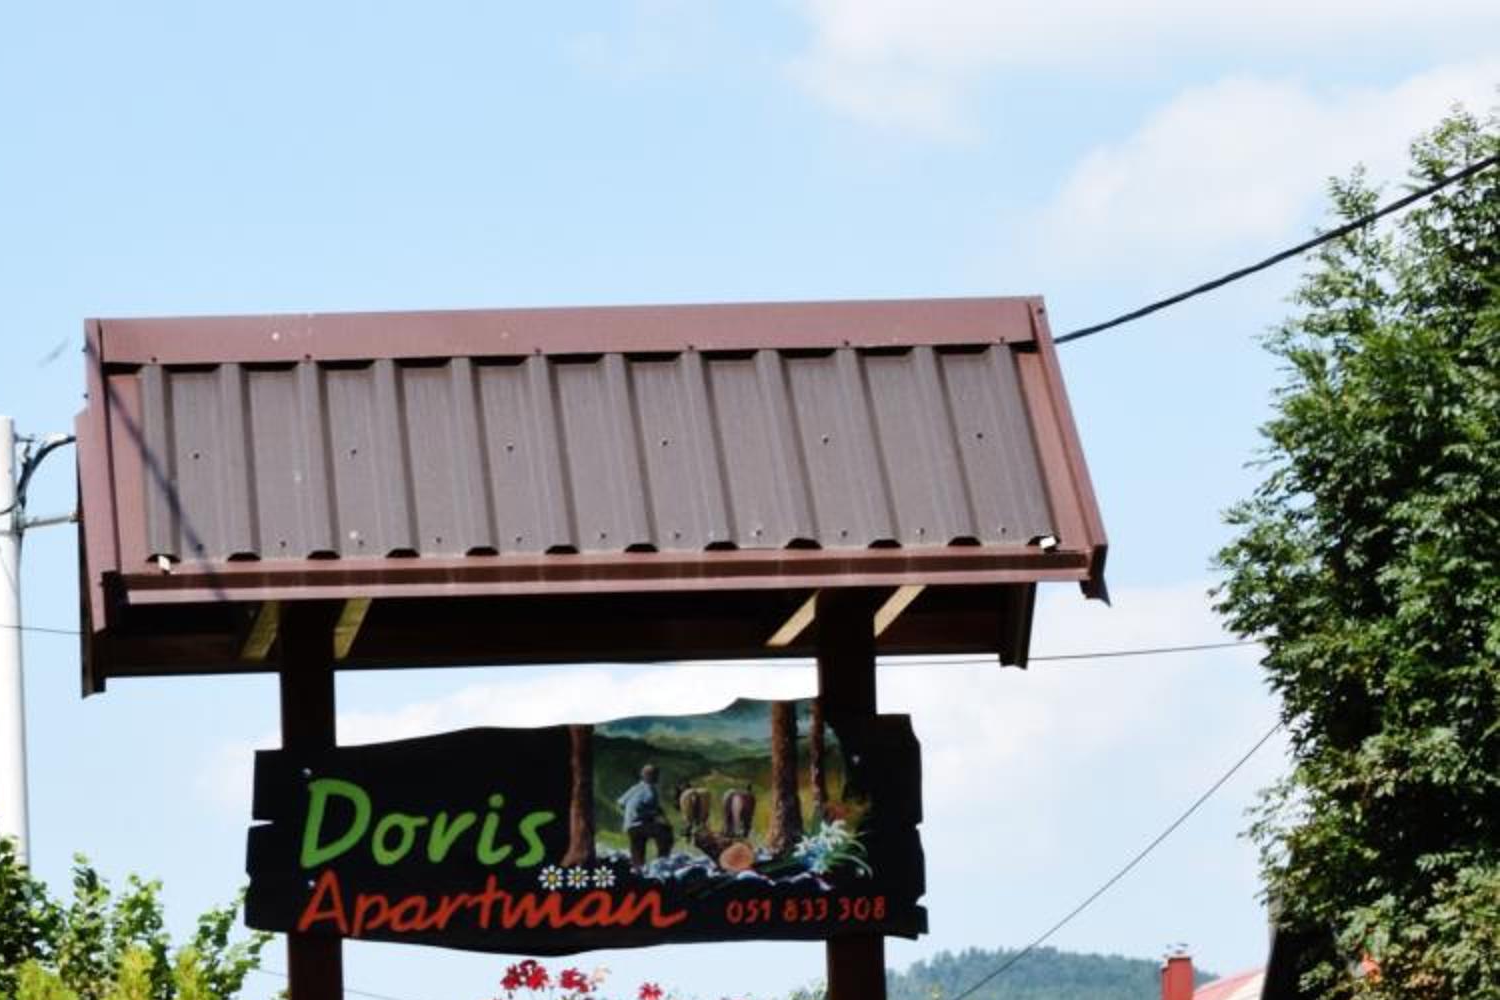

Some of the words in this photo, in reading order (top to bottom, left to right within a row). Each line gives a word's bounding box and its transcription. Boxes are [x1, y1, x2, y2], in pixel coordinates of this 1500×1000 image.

[301, 778, 556, 868] Doris
[298, 868, 688, 936] Apartman
[725, 899, 772, 924] 051
[782, 897, 829, 922] 833
[838, 896, 886, 921] 308
